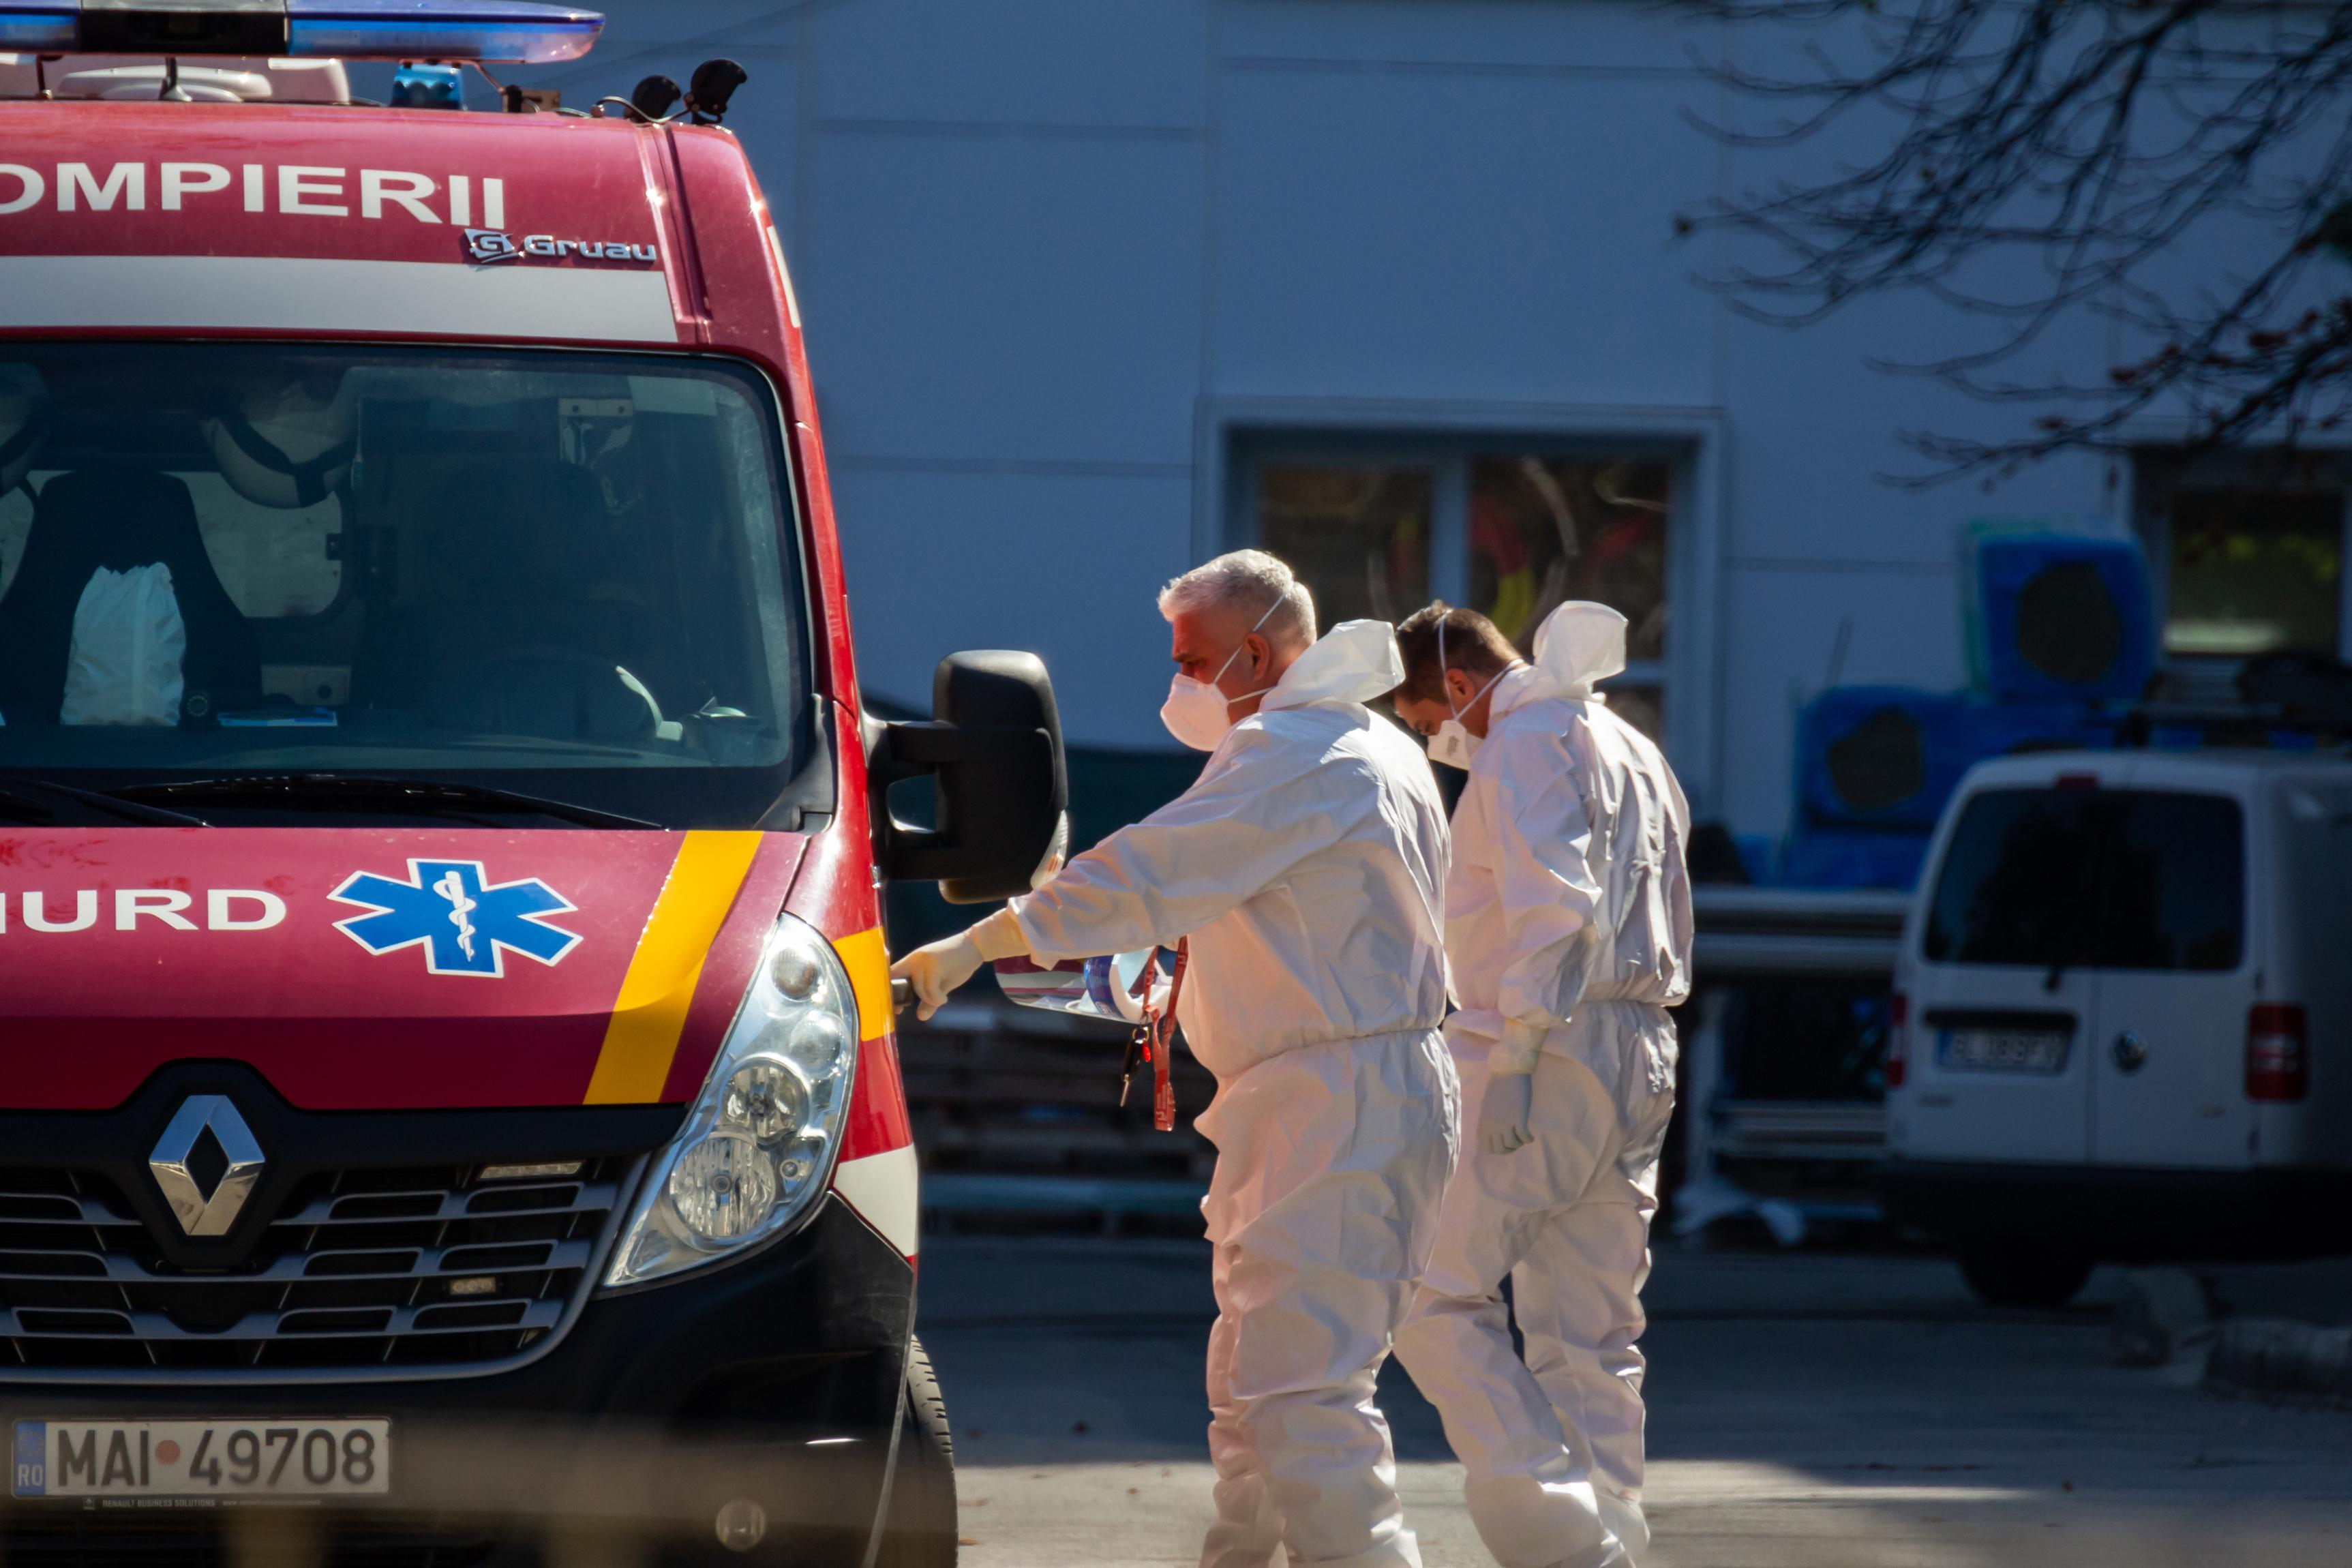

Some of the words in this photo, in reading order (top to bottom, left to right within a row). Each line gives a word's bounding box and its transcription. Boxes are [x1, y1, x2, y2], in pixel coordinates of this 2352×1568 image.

[523, 235, 657, 261] Gruau
[0, 889, 287, 933] URD
[18, 1464, 44, 1487] RO
[58, 1430, 149, 1486] MAI
[189, 1428, 375, 1486] 49708
[102, 1500, 135, 1508] RENAULT
[137, 1500, 172, 1508] BUSINESS
[174, 1499, 216, 1507] SOLUTIONS
